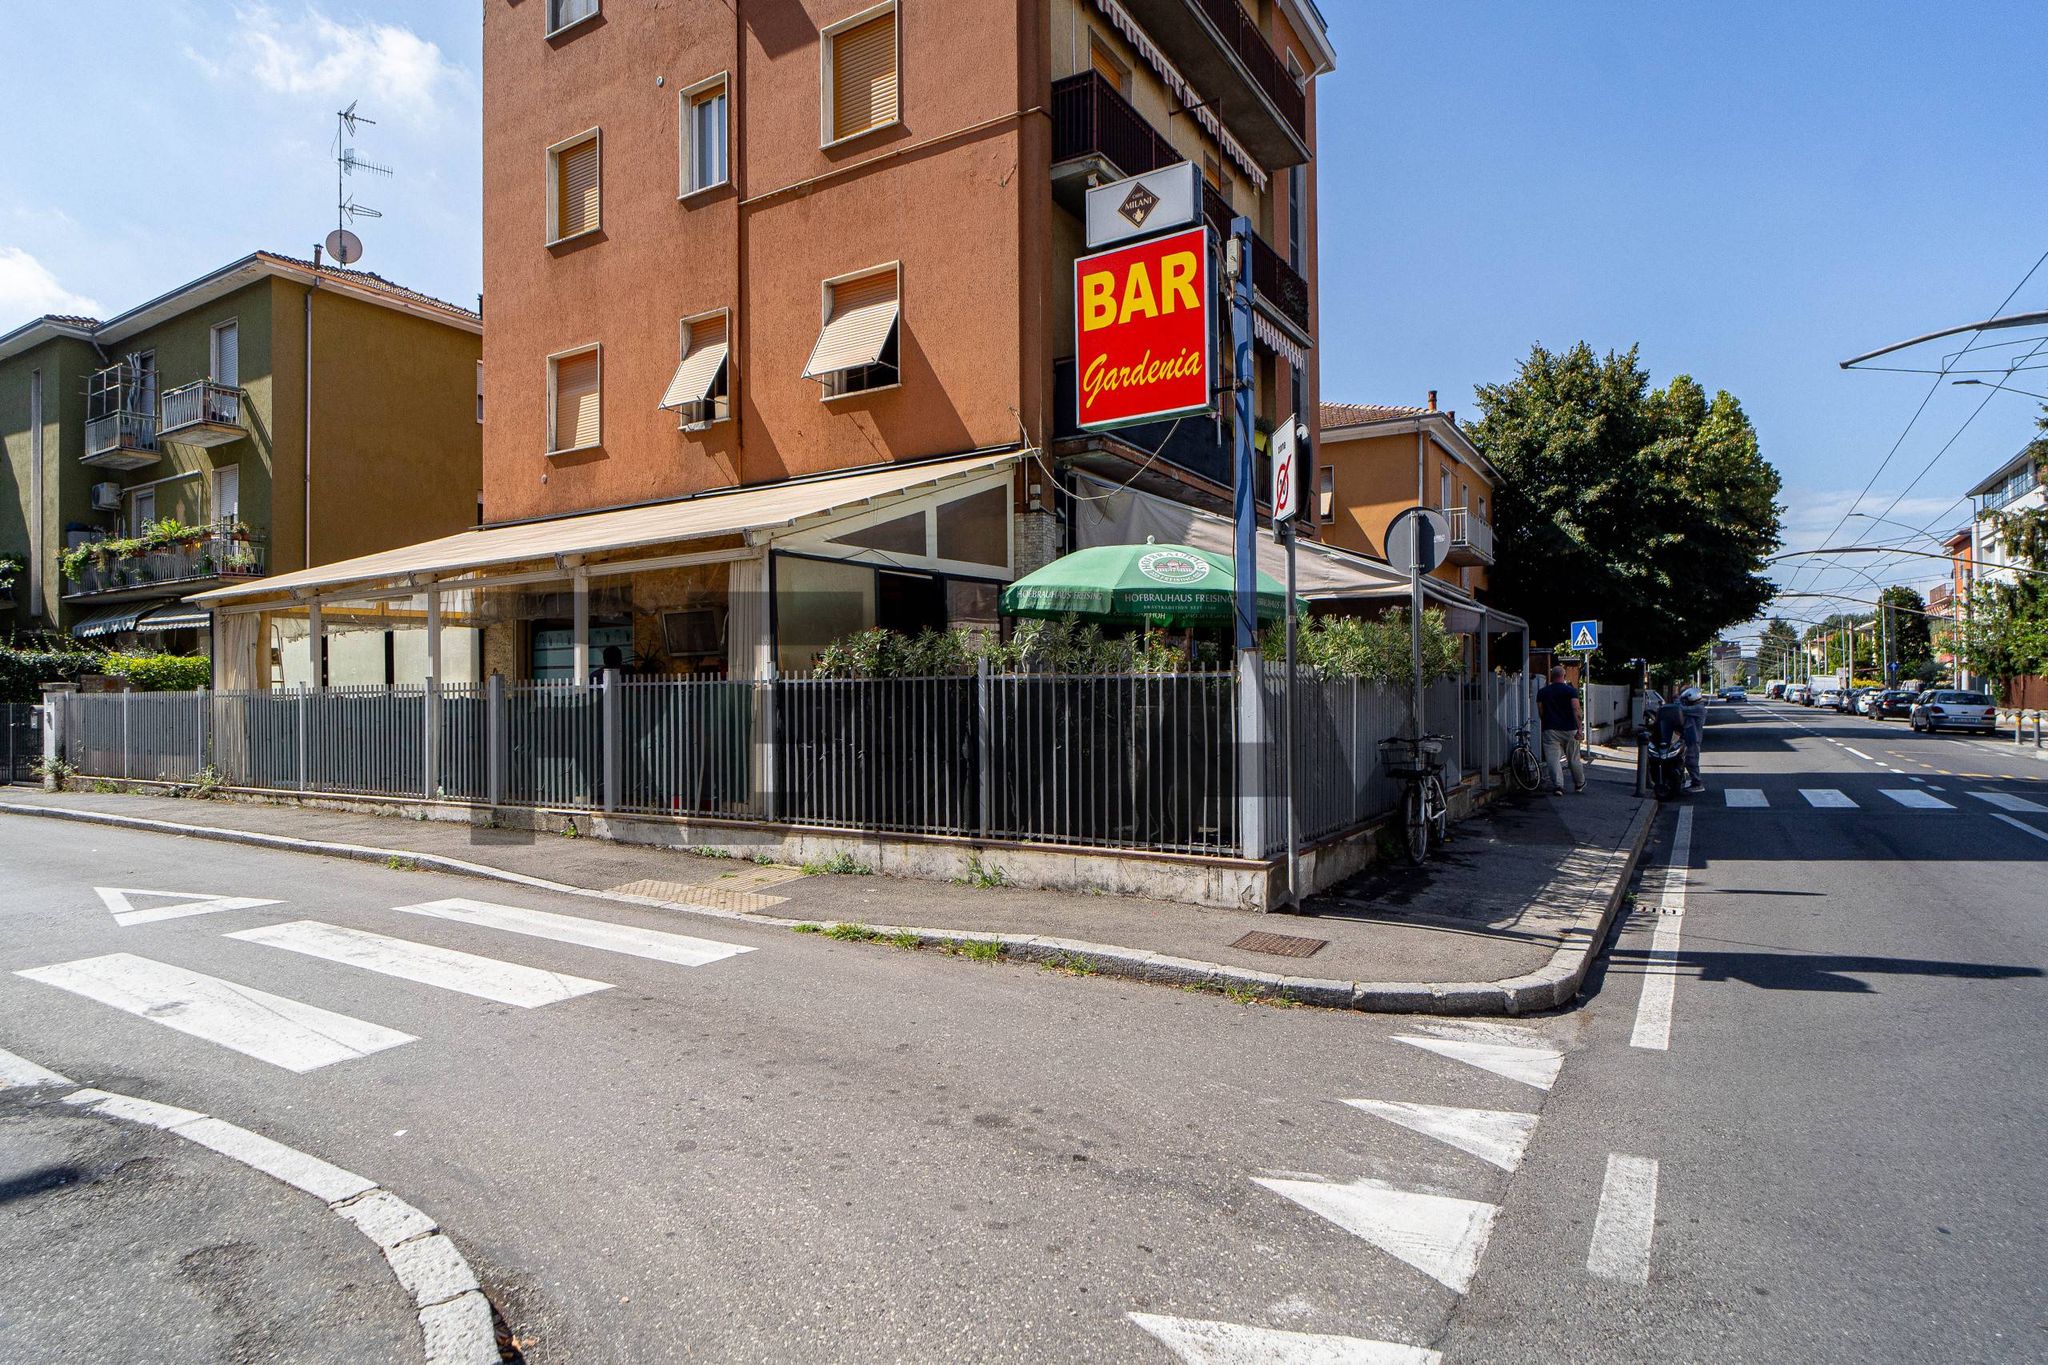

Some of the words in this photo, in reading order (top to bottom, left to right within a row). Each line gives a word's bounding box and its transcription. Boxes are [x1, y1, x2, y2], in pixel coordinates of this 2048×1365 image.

[1125, 196, 1152, 211] MILANI
[1083, 250, 1201, 332] BAR
[1083, 347, 1203, 409] Gardenia
[1124, 593, 1193, 603] HOFBRAUHAUS
